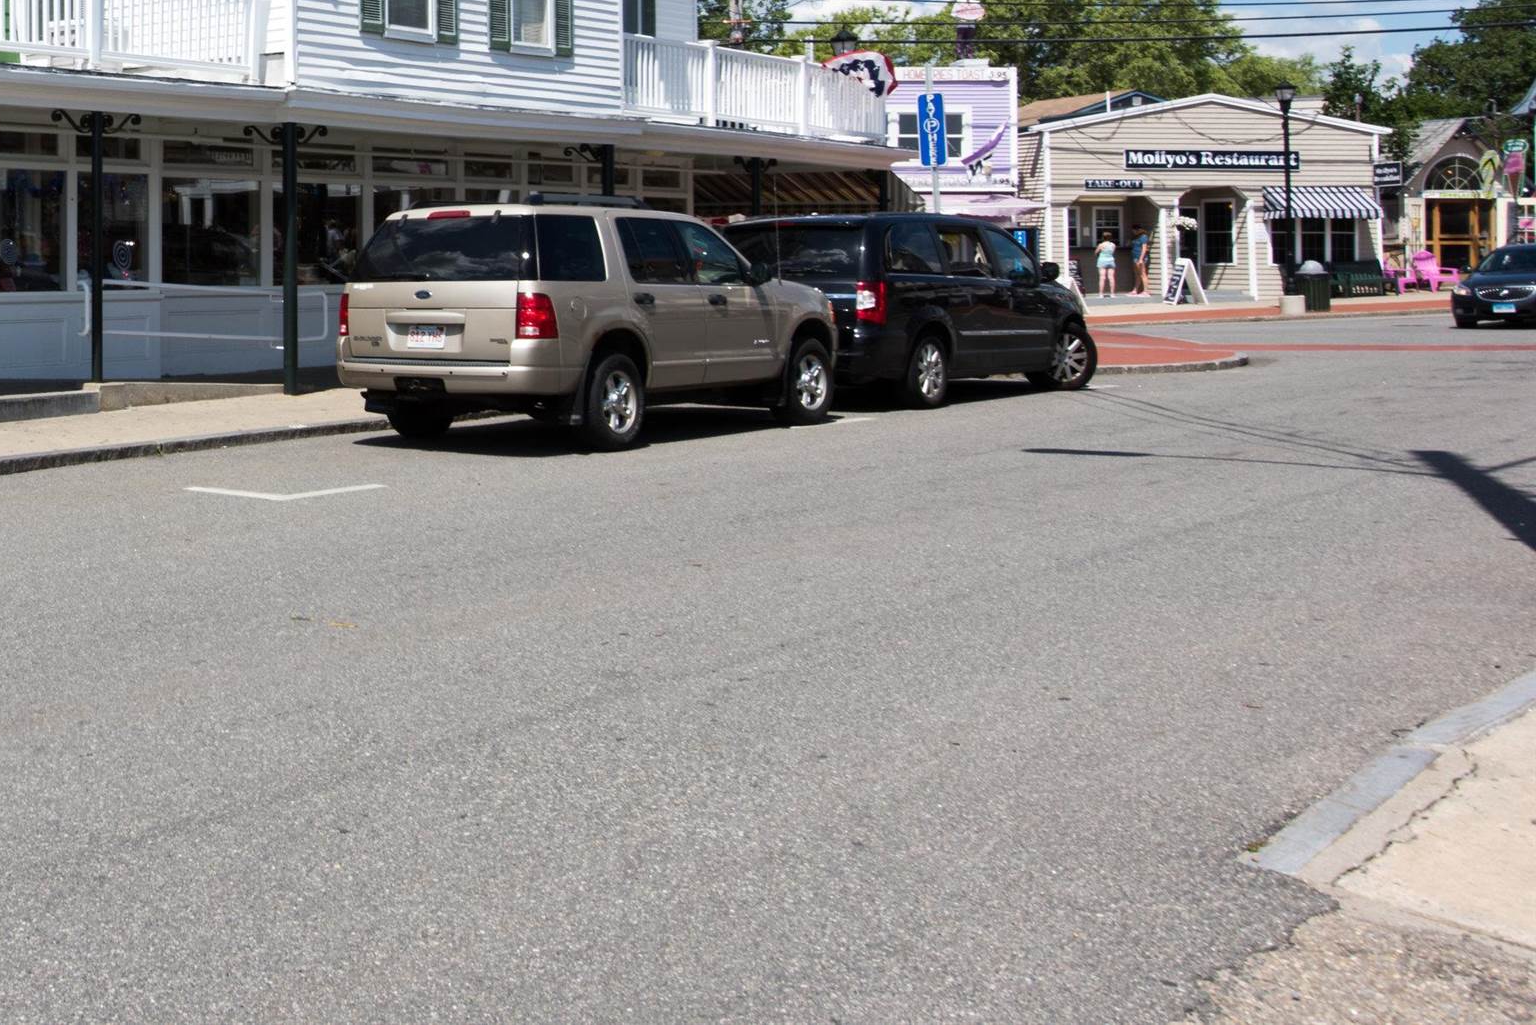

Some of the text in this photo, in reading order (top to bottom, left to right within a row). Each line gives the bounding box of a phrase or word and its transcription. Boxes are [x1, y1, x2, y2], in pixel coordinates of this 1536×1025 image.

[956, 69, 985, 79] TOAST
[927, 94, 935, 118] PAY
[1128, 151, 1197, 168] Mollyo's
